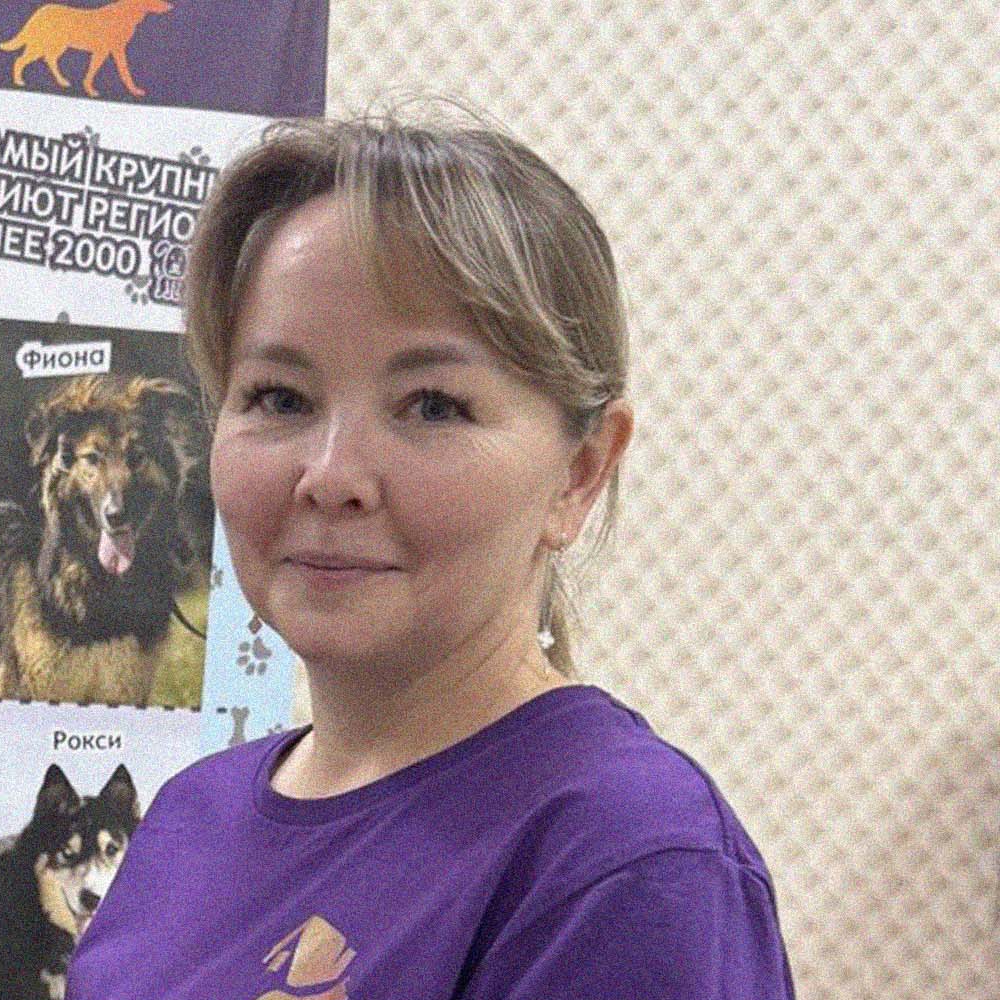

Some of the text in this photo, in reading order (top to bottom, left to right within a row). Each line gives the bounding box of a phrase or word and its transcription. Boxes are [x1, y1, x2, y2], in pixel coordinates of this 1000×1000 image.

[96, 150, 216, 200] КРУПН
[88, 196, 196, 242] РЕГИО
[54, 235, 138, 275] 2000
[21, 346, 105, 371] Фиона
[53, 730, 122, 750] Рокси
